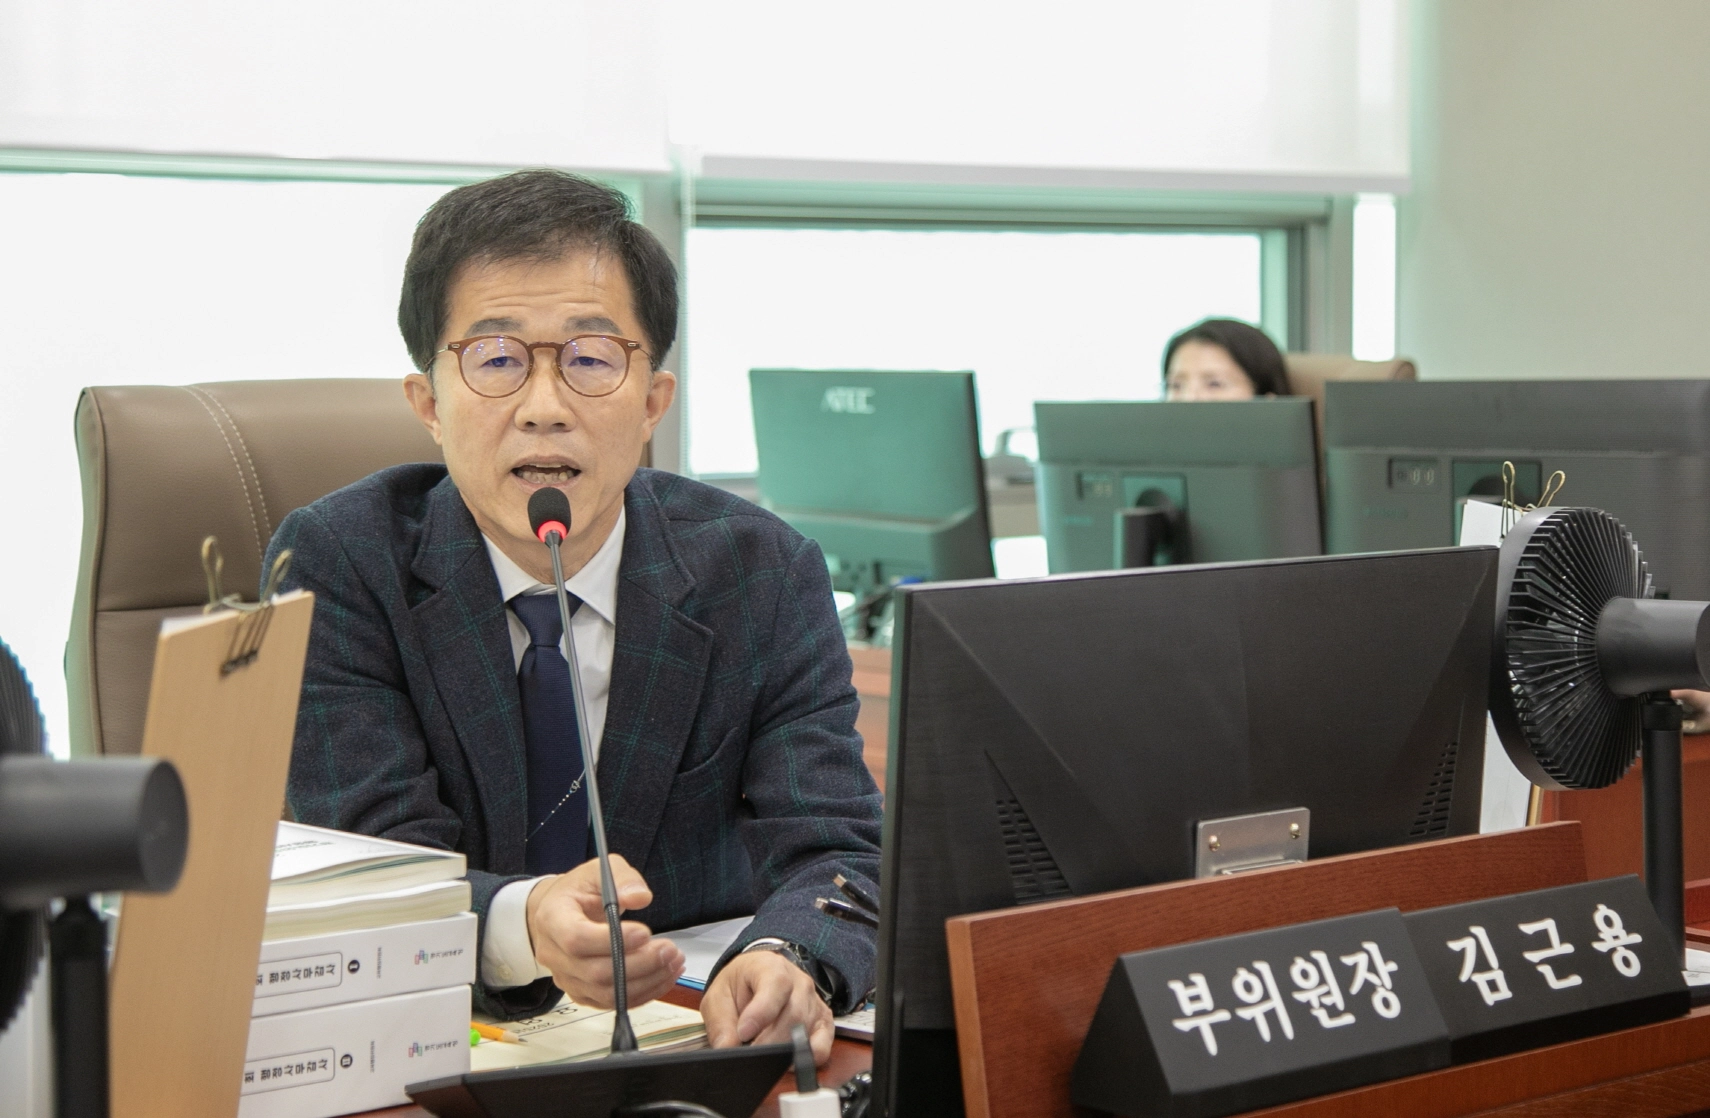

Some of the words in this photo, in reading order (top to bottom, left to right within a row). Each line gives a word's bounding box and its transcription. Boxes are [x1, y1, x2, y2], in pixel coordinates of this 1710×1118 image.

[269, 964, 336, 984] 행정사무감사
[1447, 904, 1642, 1006] 김근용
[1168, 941, 1401, 1056] 부위원장
[260, 1059, 328, 1081] 행정사무감사
